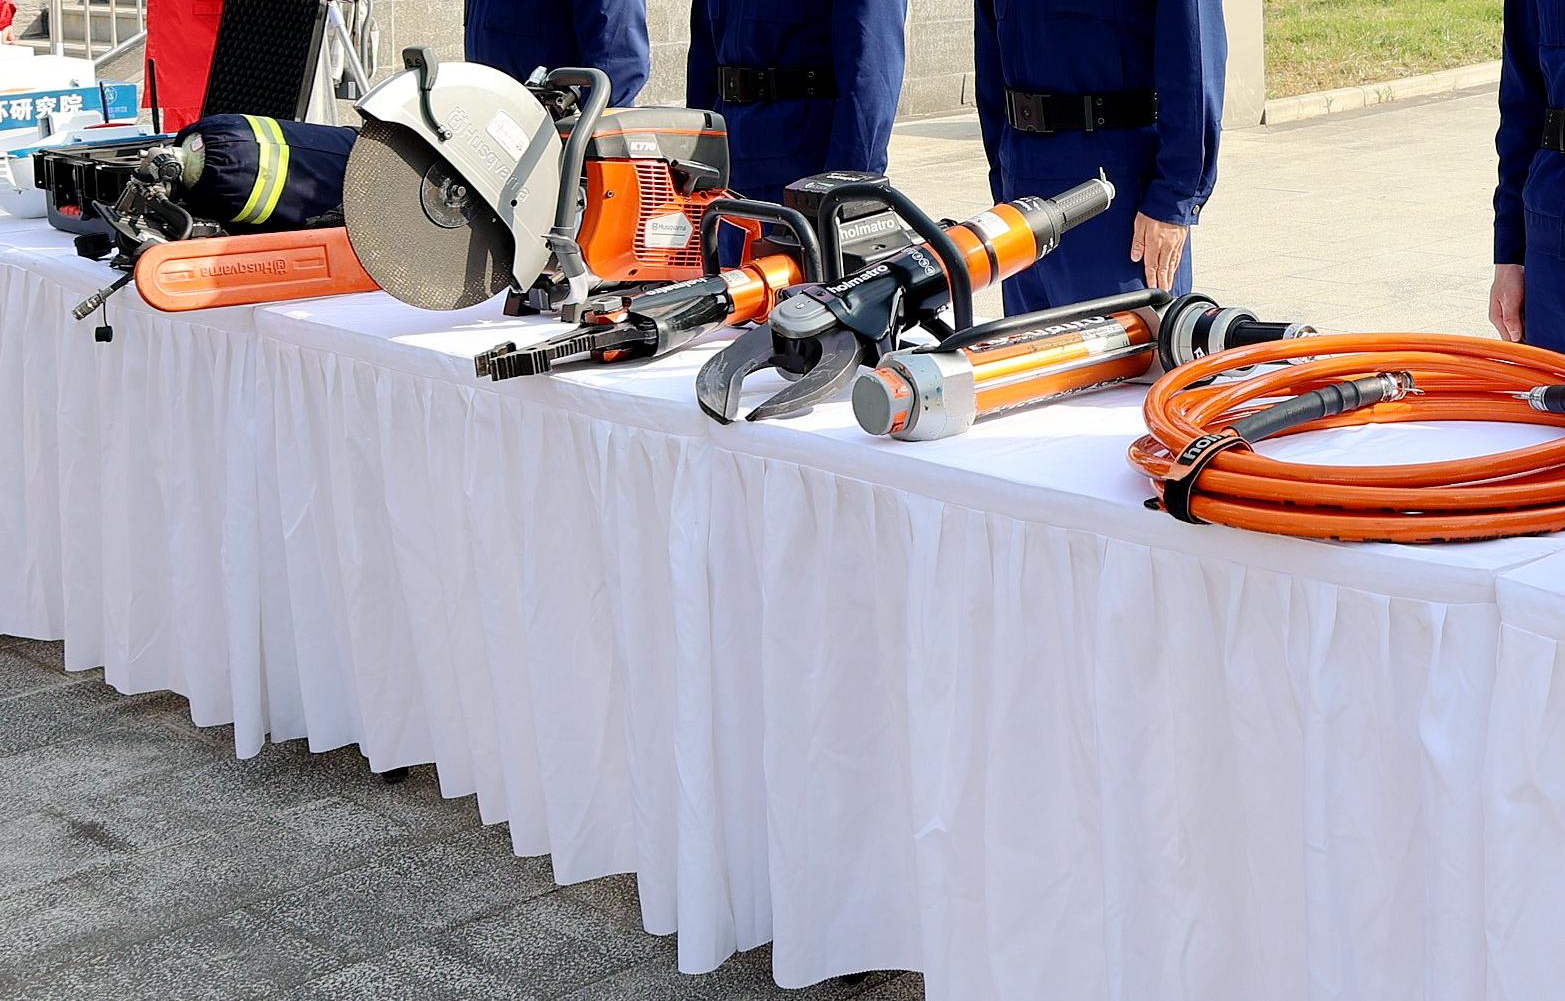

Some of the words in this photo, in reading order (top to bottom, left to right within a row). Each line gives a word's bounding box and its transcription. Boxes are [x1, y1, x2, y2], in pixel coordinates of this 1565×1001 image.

[840, 219, 895, 240] holmatro
[201, 261, 274, 278] Husqvarna
[826, 264, 889, 294] holmatro
